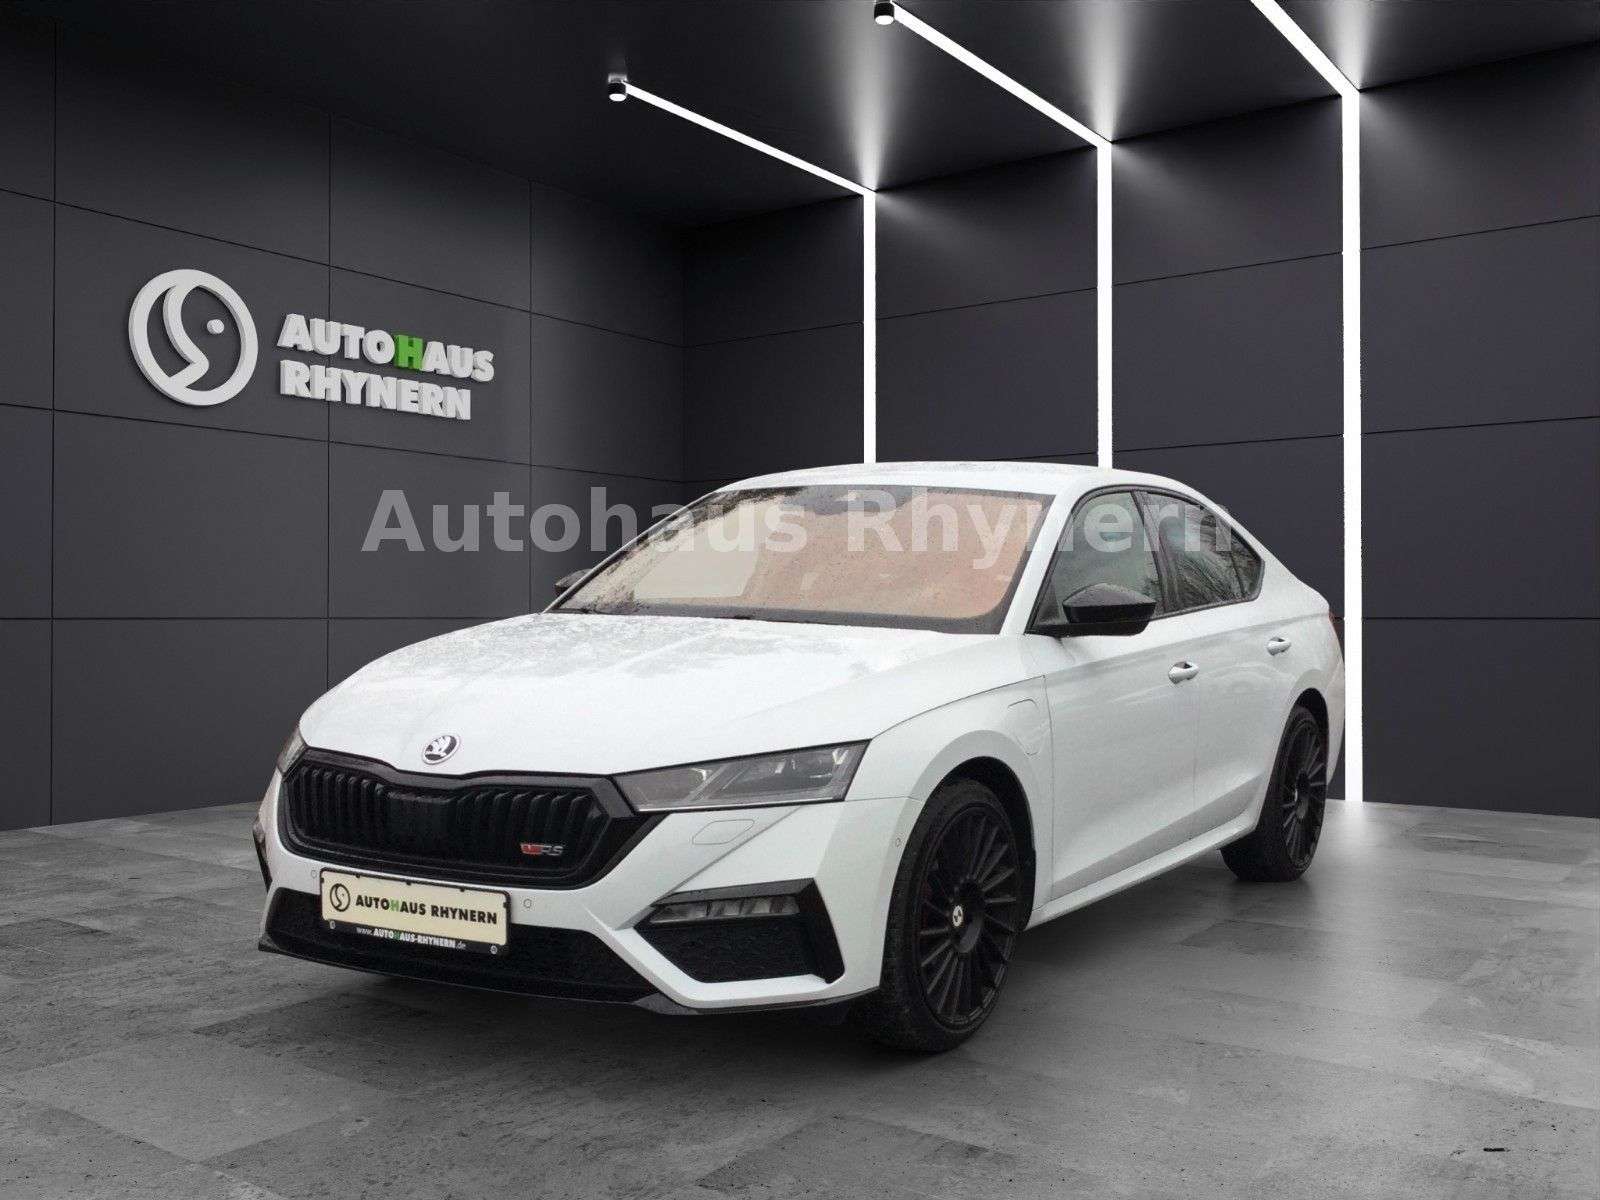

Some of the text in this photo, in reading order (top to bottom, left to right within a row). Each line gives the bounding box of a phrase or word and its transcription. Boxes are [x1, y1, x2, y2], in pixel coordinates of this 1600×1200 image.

[277, 313, 495, 382] AUTOHAUS
[279, 360, 472, 420] RHYNERN
[355, 894, 498, 925] AUTOHAUS RHYNERN
